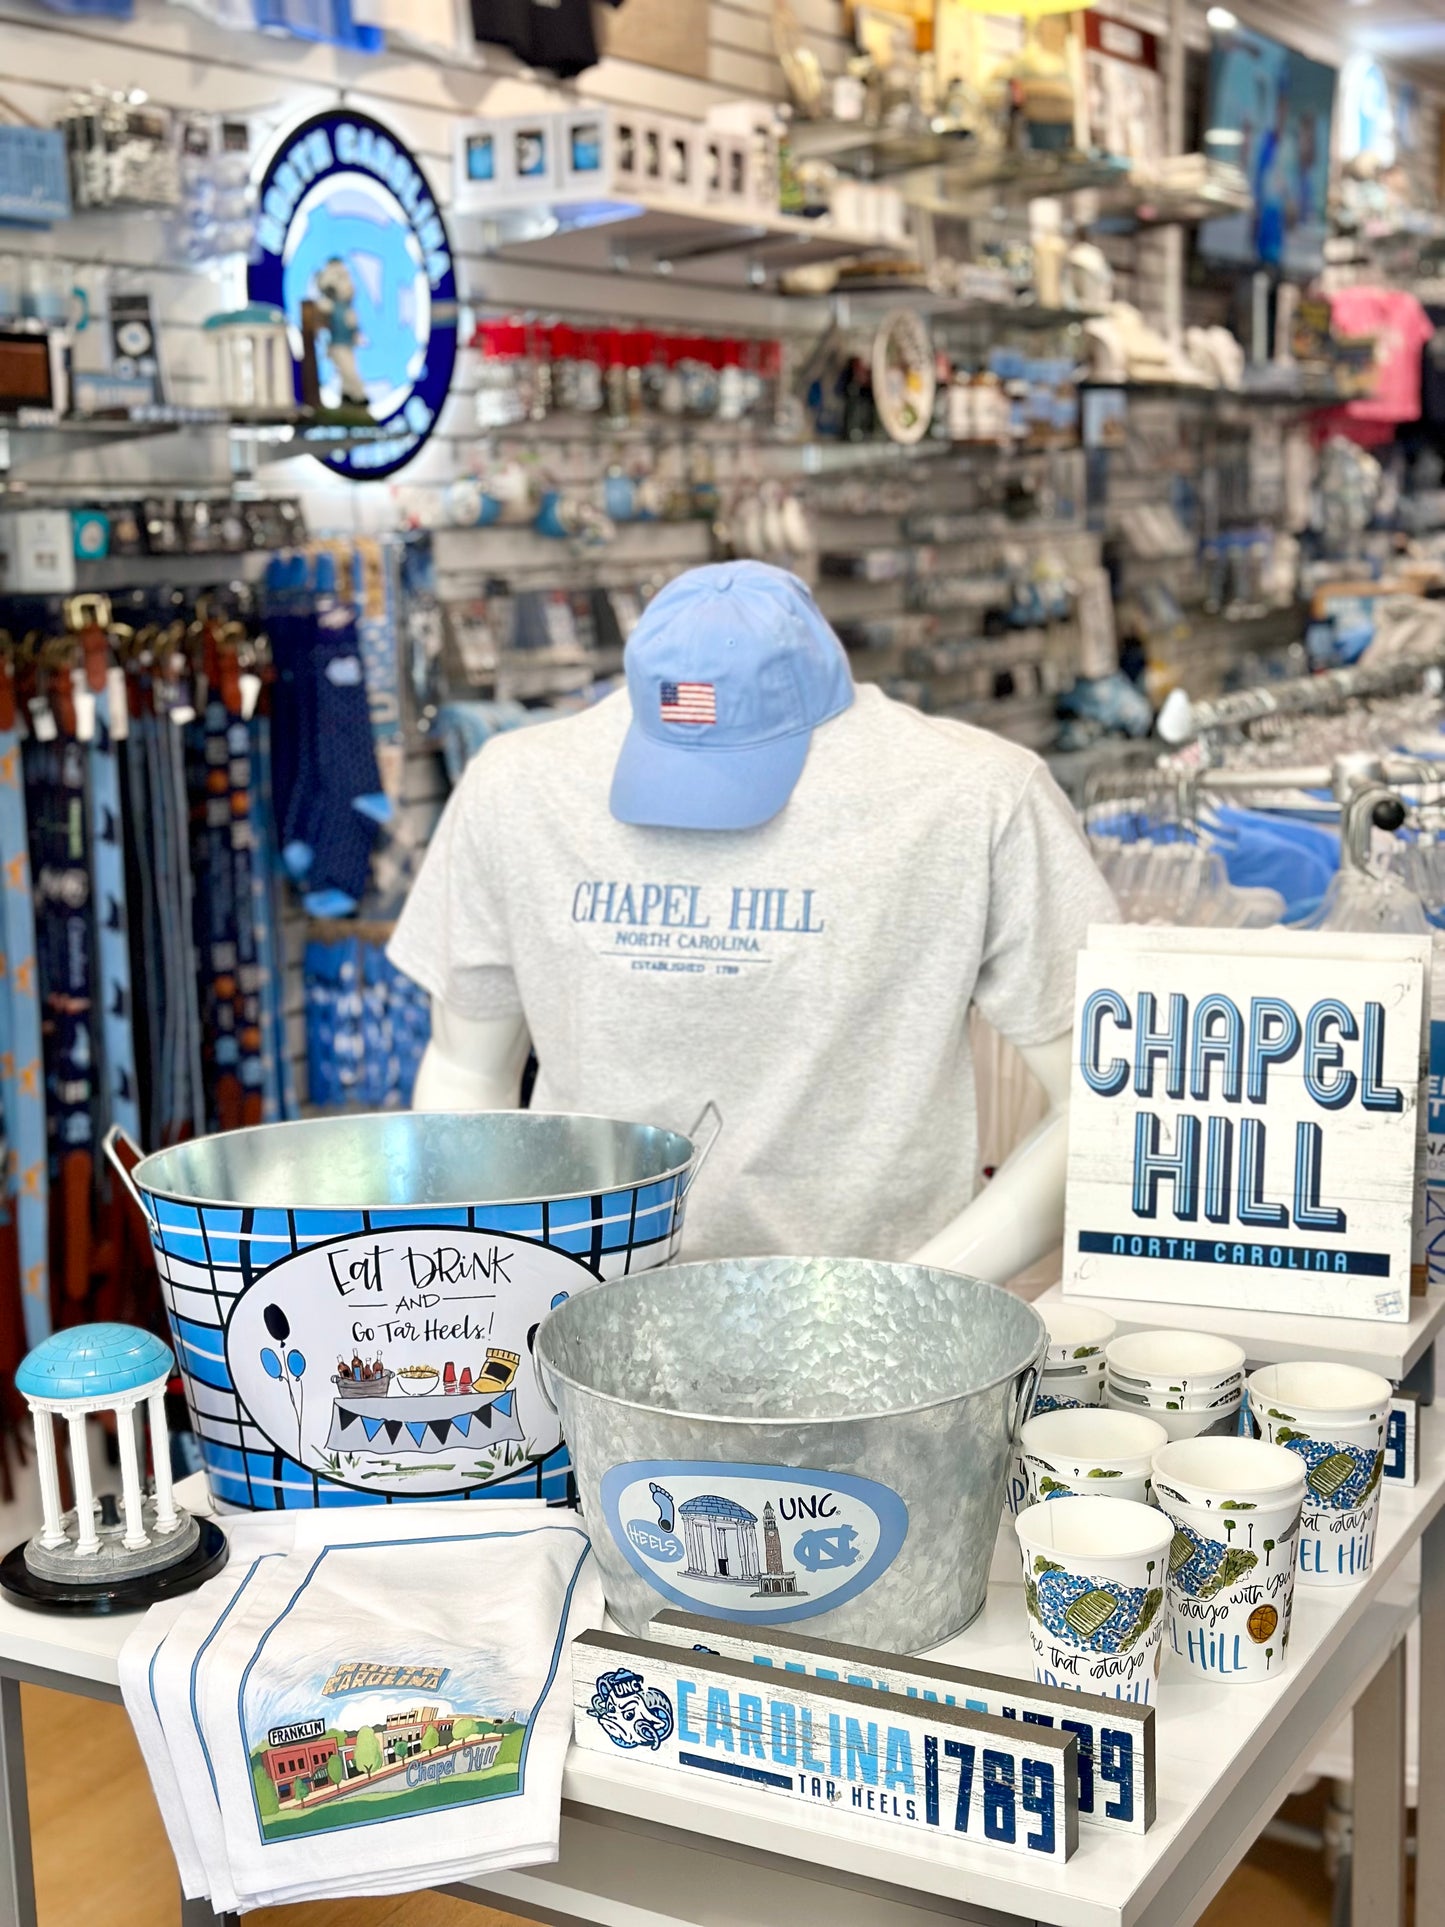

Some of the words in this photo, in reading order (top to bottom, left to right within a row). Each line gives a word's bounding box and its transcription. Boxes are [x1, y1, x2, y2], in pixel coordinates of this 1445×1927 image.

[572, 881, 711, 928] CHAPEL
[728, 886, 825, 933] HILL
[615, 932, 671, 948] NORTH
[677, 934, 761, 952] CAROLINA
[631, 960, 705, 973] ESTABLISHED
[1079, 988, 1403, 1112] CHAPEL
[1131, 1111, 1347, 1233] HILL
[1112, 1234, 1197, 1260] NORTH
[1213, 1242, 1348, 1272] CAROLINA
[327, 1245, 394, 1297] Eat
[395, 1293, 441, 1313] AND
[352, 1321, 375, 1343] Go
[377, 1319, 421, 1343] Tar
[779, 1493, 837, 1520] UNC
[628, 1526, 677, 1556] HEELS
[1300, 1539, 1329, 1573] EL
[1178, 1597, 1229, 1627] stays
[1229, 1584, 1264, 1605] with
[1047, 1646, 1091, 1676] that
[1090, 1651, 1145, 1681] stays
[321, 1671, 440, 1695] CAROLINA
[614, 1679, 641, 1695] UNC
[271, 1721, 323, 1744] FRANKLIN
[675, 1679, 917, 1796] CAROLINA
[406, 1751, 457, 1787] Chapel
[462, 1745, 498, 1773] Hill
[798, 1773, 835, 1801] TAR
[923, 1734, 1056, 1854] 1789
